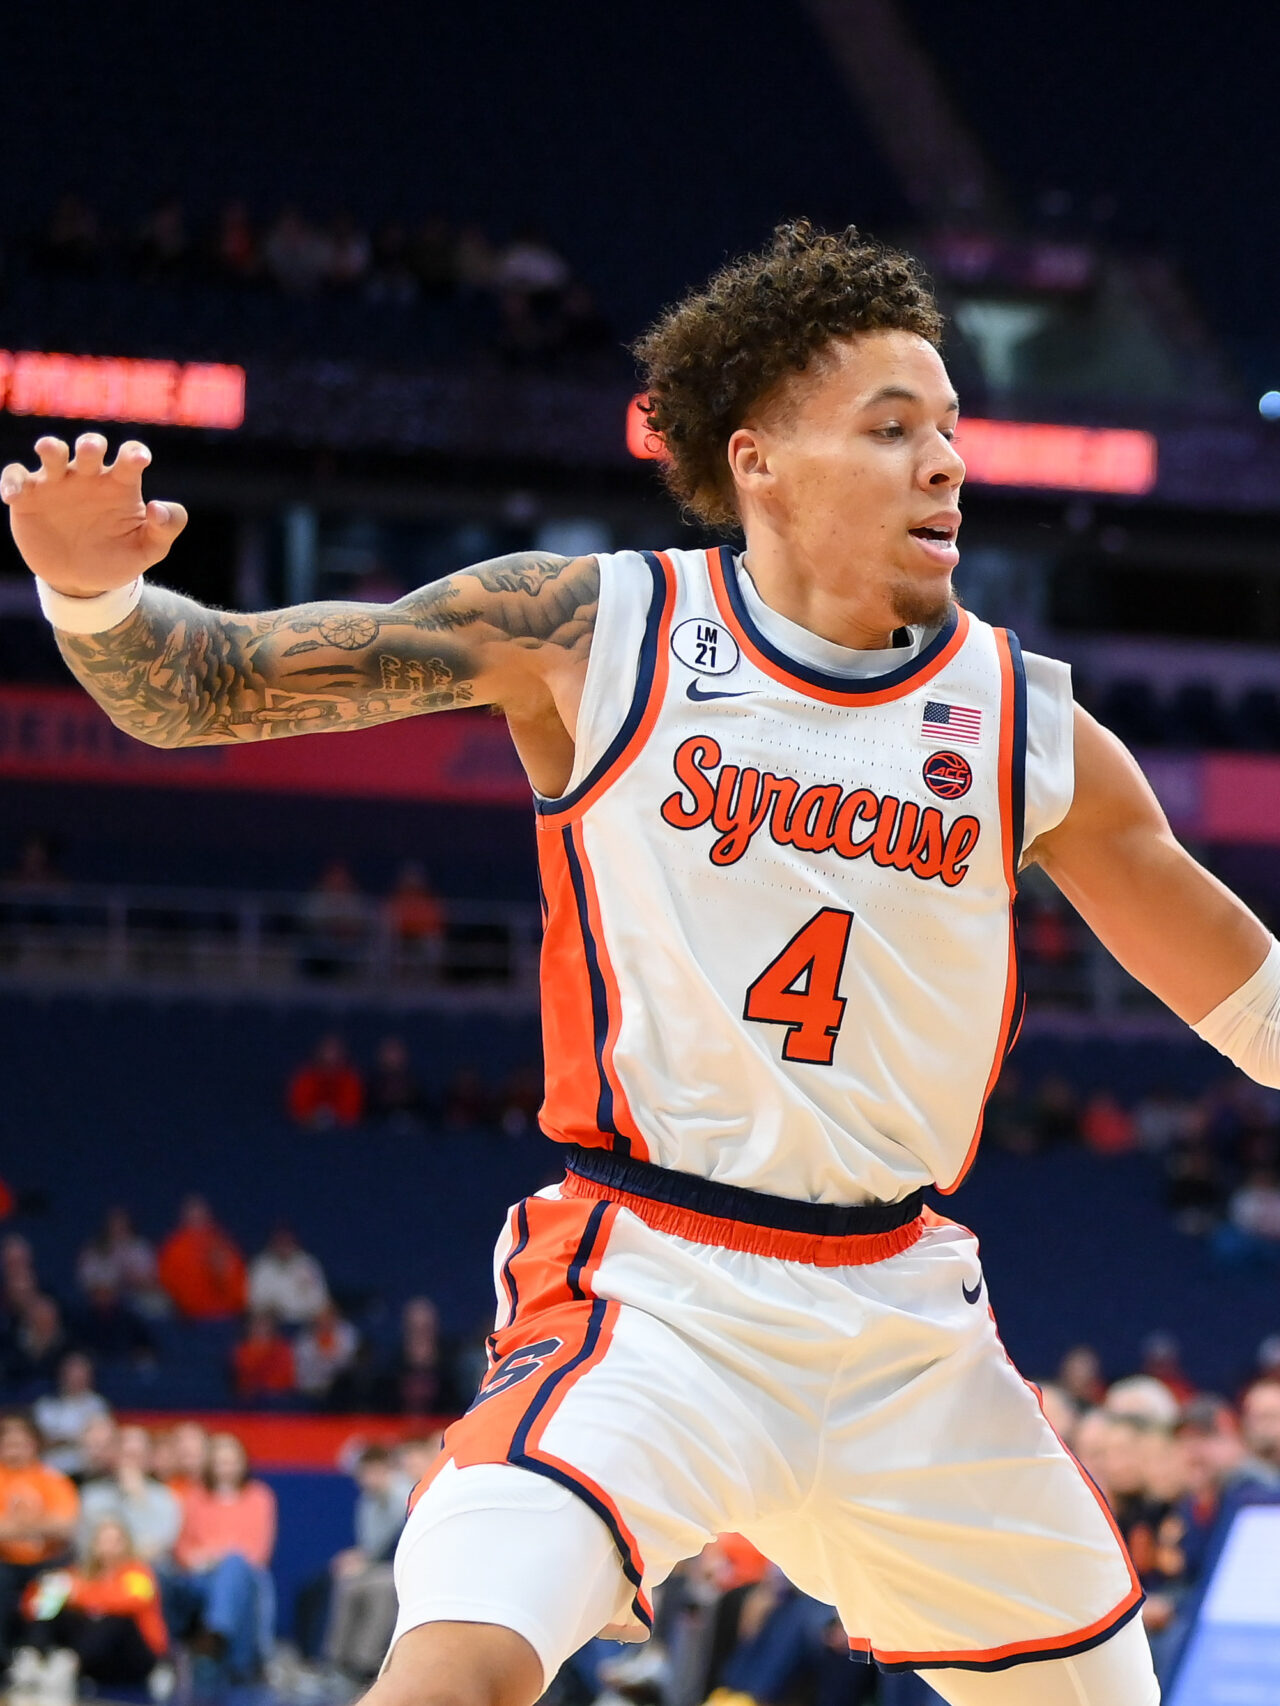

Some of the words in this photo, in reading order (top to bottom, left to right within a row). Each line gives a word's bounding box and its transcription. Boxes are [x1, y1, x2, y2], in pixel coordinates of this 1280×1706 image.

[695, 642, 716, 668] 21
[697, 624, 717, 644] LM
[931, 766, 969, 781] ACC
[660, 735, 981, 887] Syracuse
[743, 906, 854, 1065] 4
[465, 1336, 564, 1415] S
